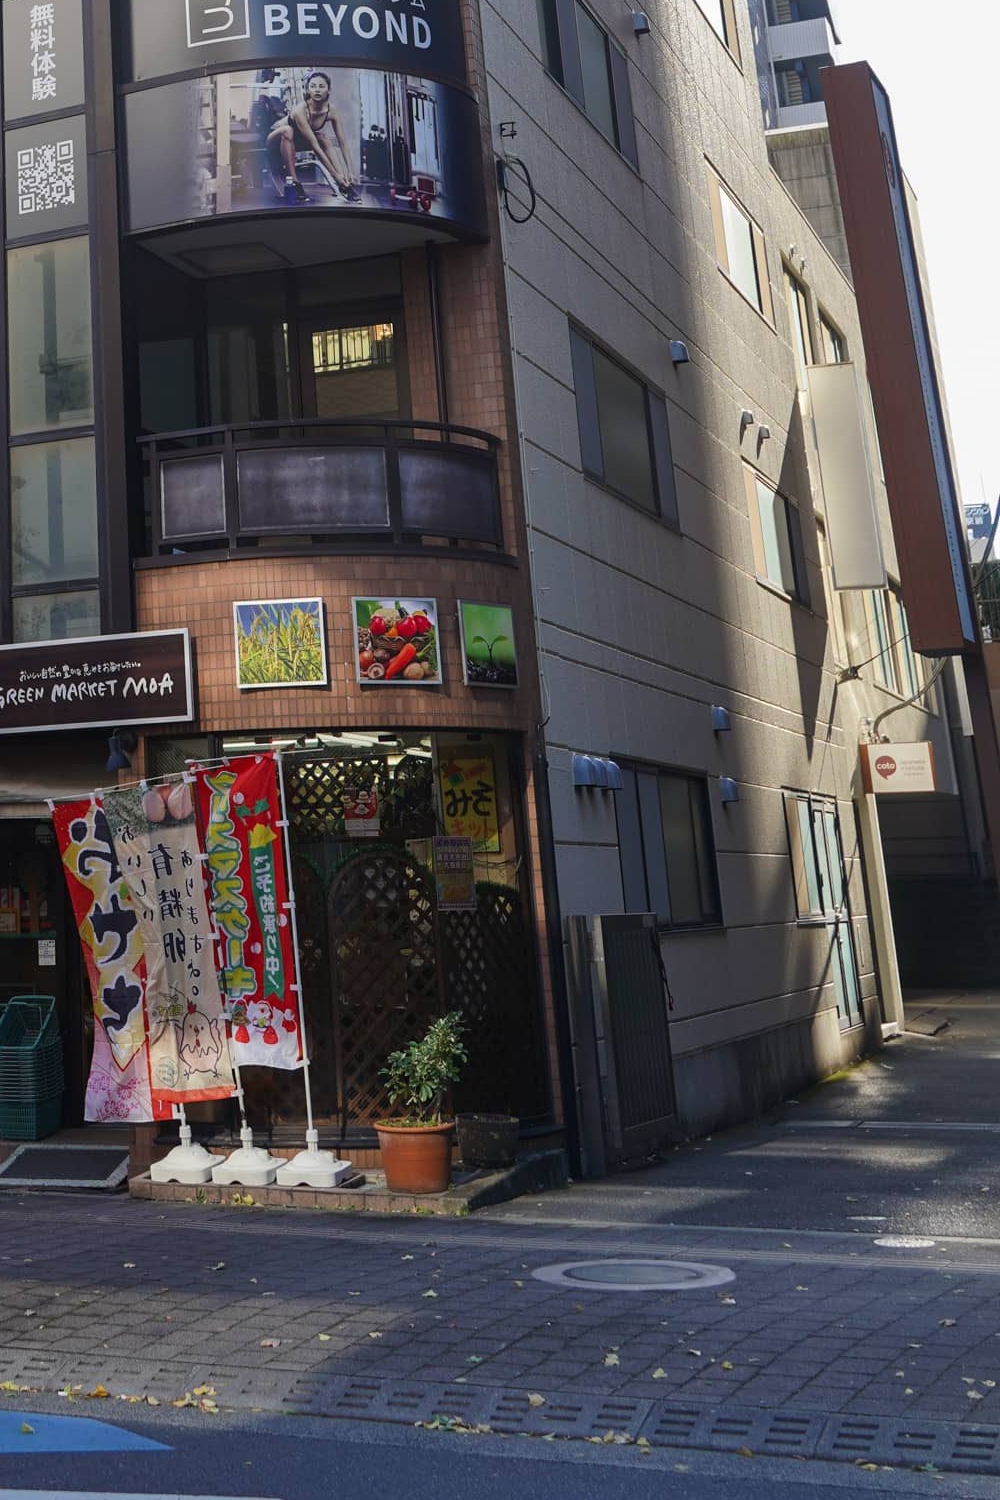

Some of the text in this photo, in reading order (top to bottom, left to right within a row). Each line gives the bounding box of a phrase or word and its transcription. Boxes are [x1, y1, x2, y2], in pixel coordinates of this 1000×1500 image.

[263, 3, 432, 49] BEYOND
[29, 3, 57, 101] 無料体験
[51, 679, 118, 703] MARKET
[876, 762, 896, 770] coto
